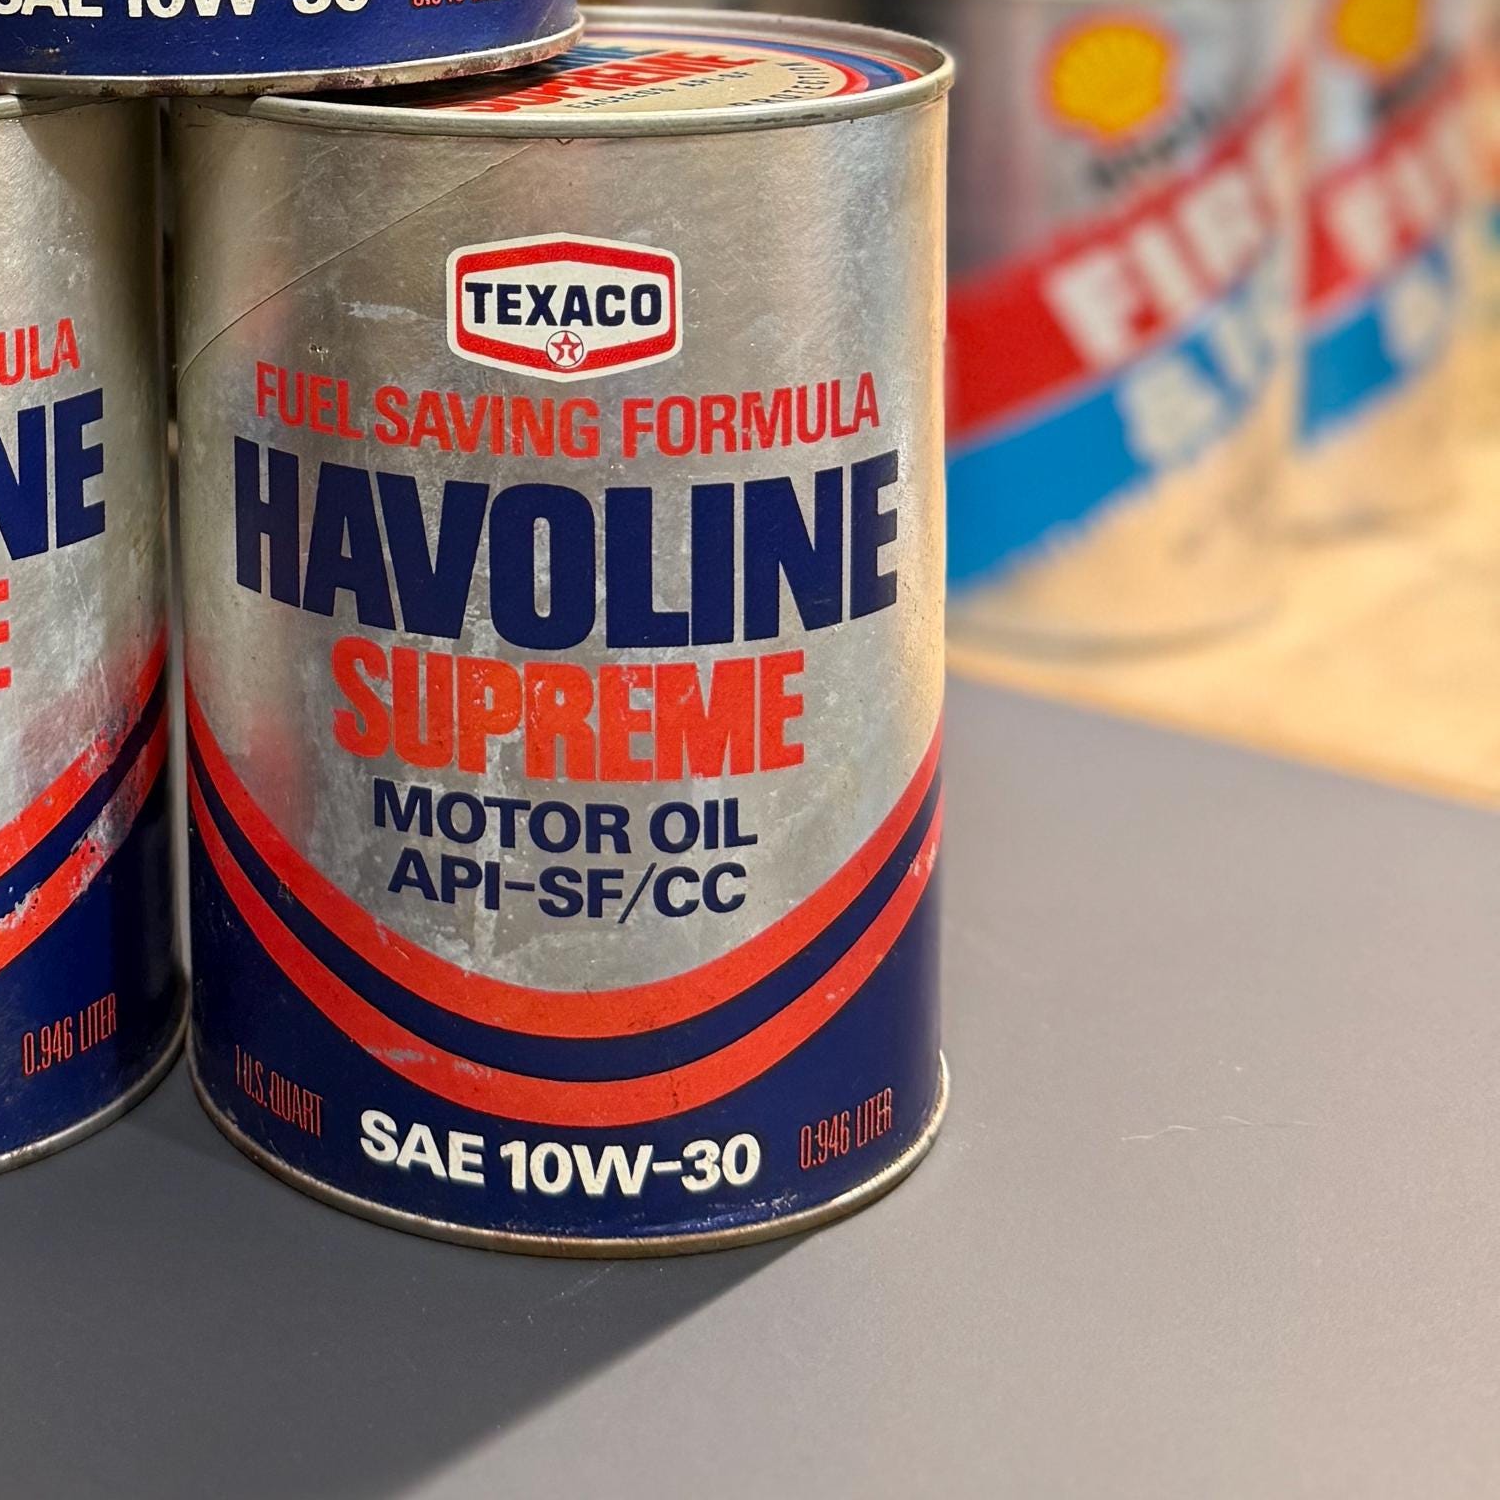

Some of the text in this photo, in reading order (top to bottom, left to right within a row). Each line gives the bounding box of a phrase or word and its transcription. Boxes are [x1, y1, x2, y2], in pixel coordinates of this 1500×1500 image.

[465, 282, 662, 327] TEXACO
[255, 361, 880, 458] FUEL SAVING FORMULA
[234, 435, 898, 650] HAVOLINE
[331, 635, 806, 782] SUPREME
[374, 778, 758, 854] MOTOR OIL
[388, 854, 746, 924] API-SF/CC
[22, 992, 117, 1075] 0.946 LITER
[243, 1051, 267, 1108] U.S.
[269, 1071, 323, 1137] QUART
[800, 1088, 893, 1170] 0.946 LITER
[360, 1110, 761, 1198] SAE 10W-30
